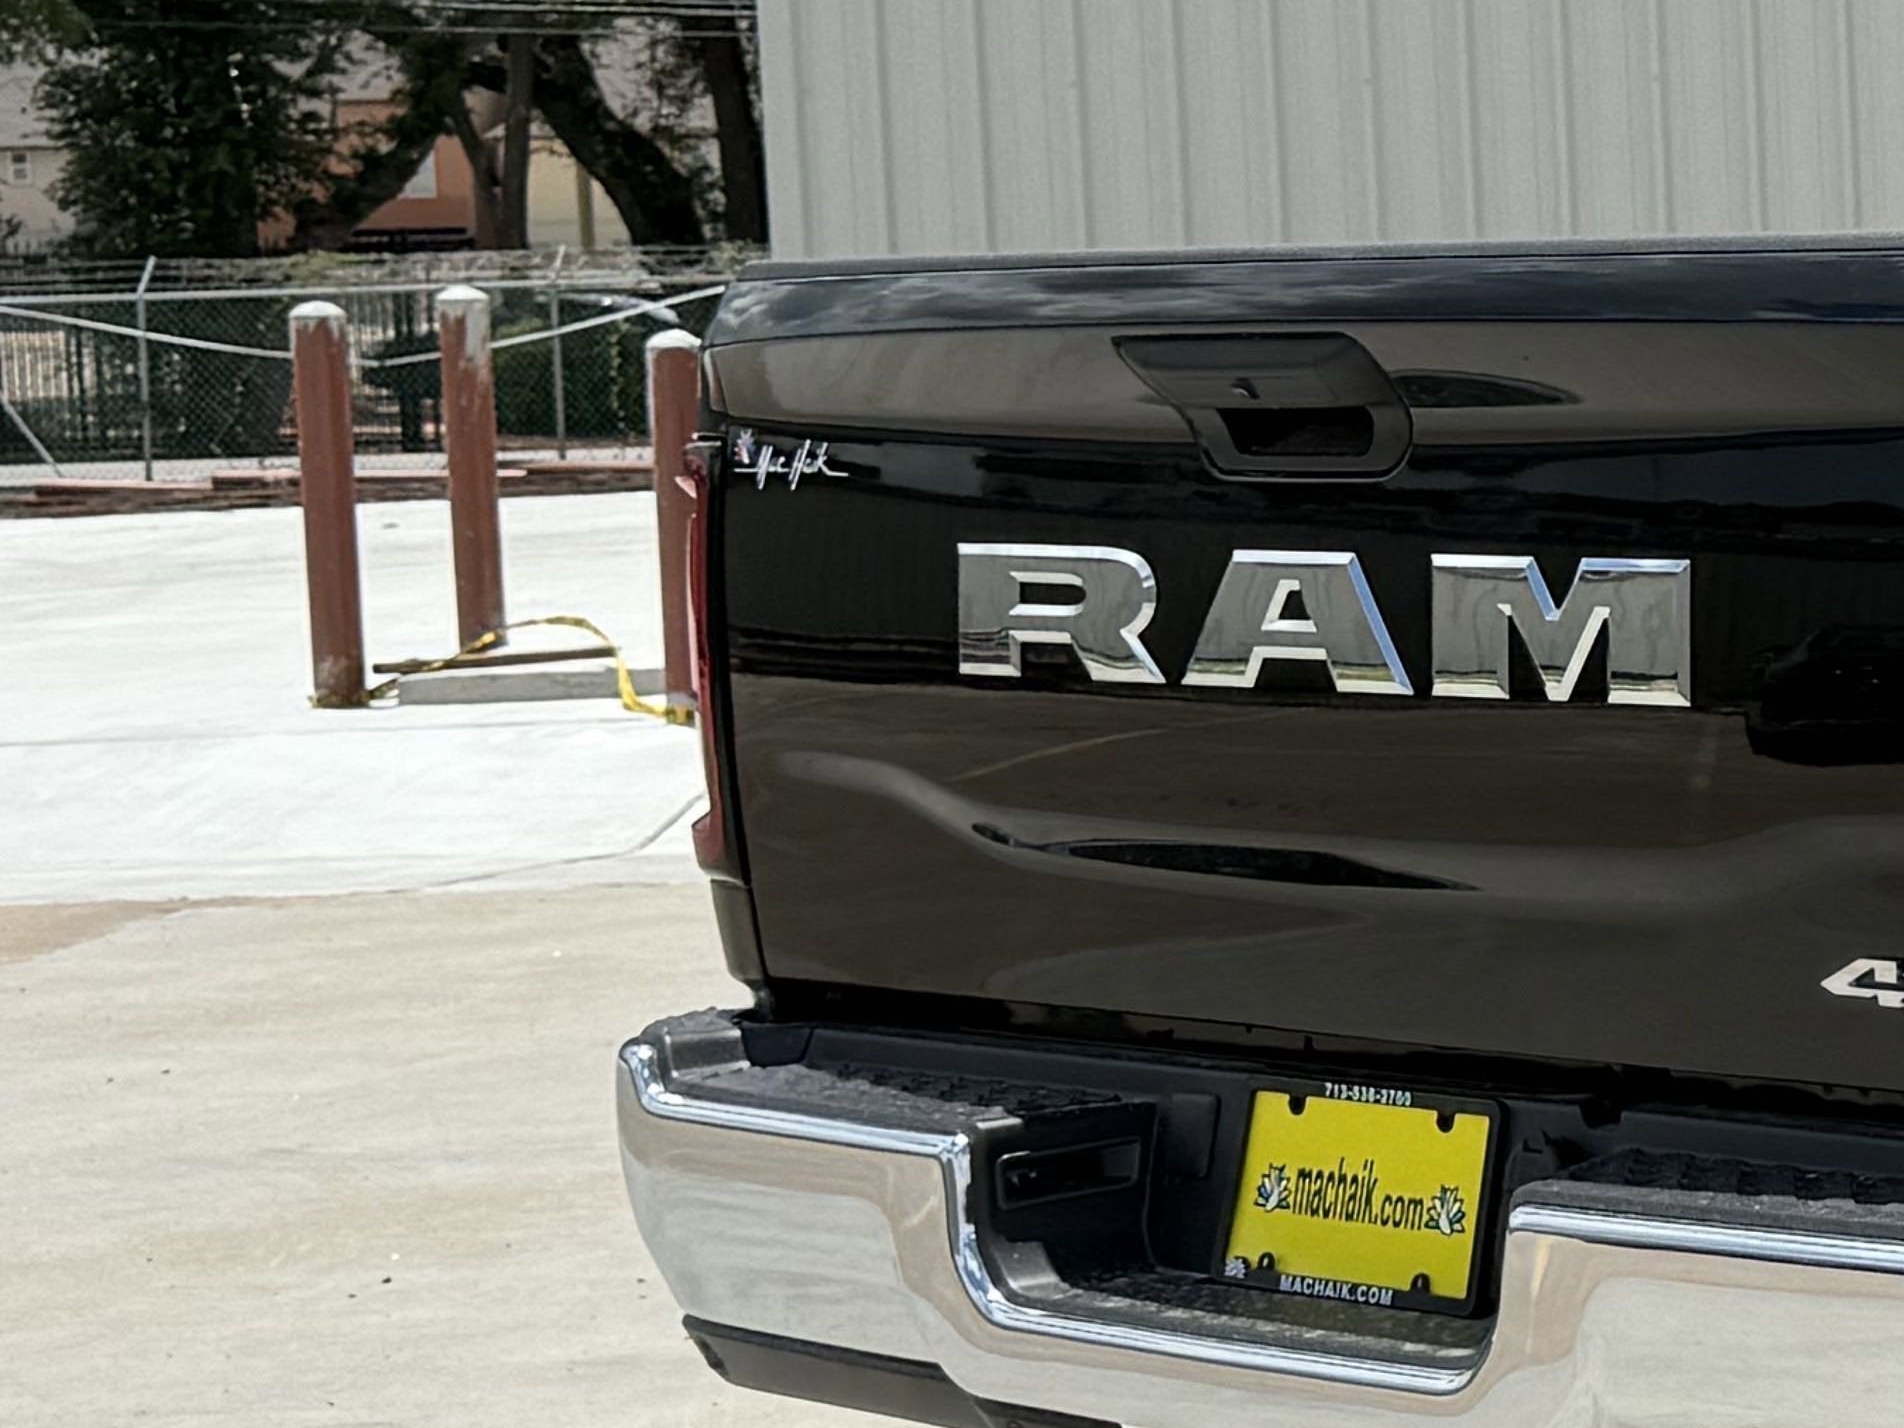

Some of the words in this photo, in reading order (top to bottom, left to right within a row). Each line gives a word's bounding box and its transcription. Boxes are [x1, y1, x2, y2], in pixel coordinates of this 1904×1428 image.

[955, 541, 1693, 708] RAM
[1291, 1157, 1427, 1231] machaik.com
[1278, 1274, 1394, 1307] MACHAIK.COM
